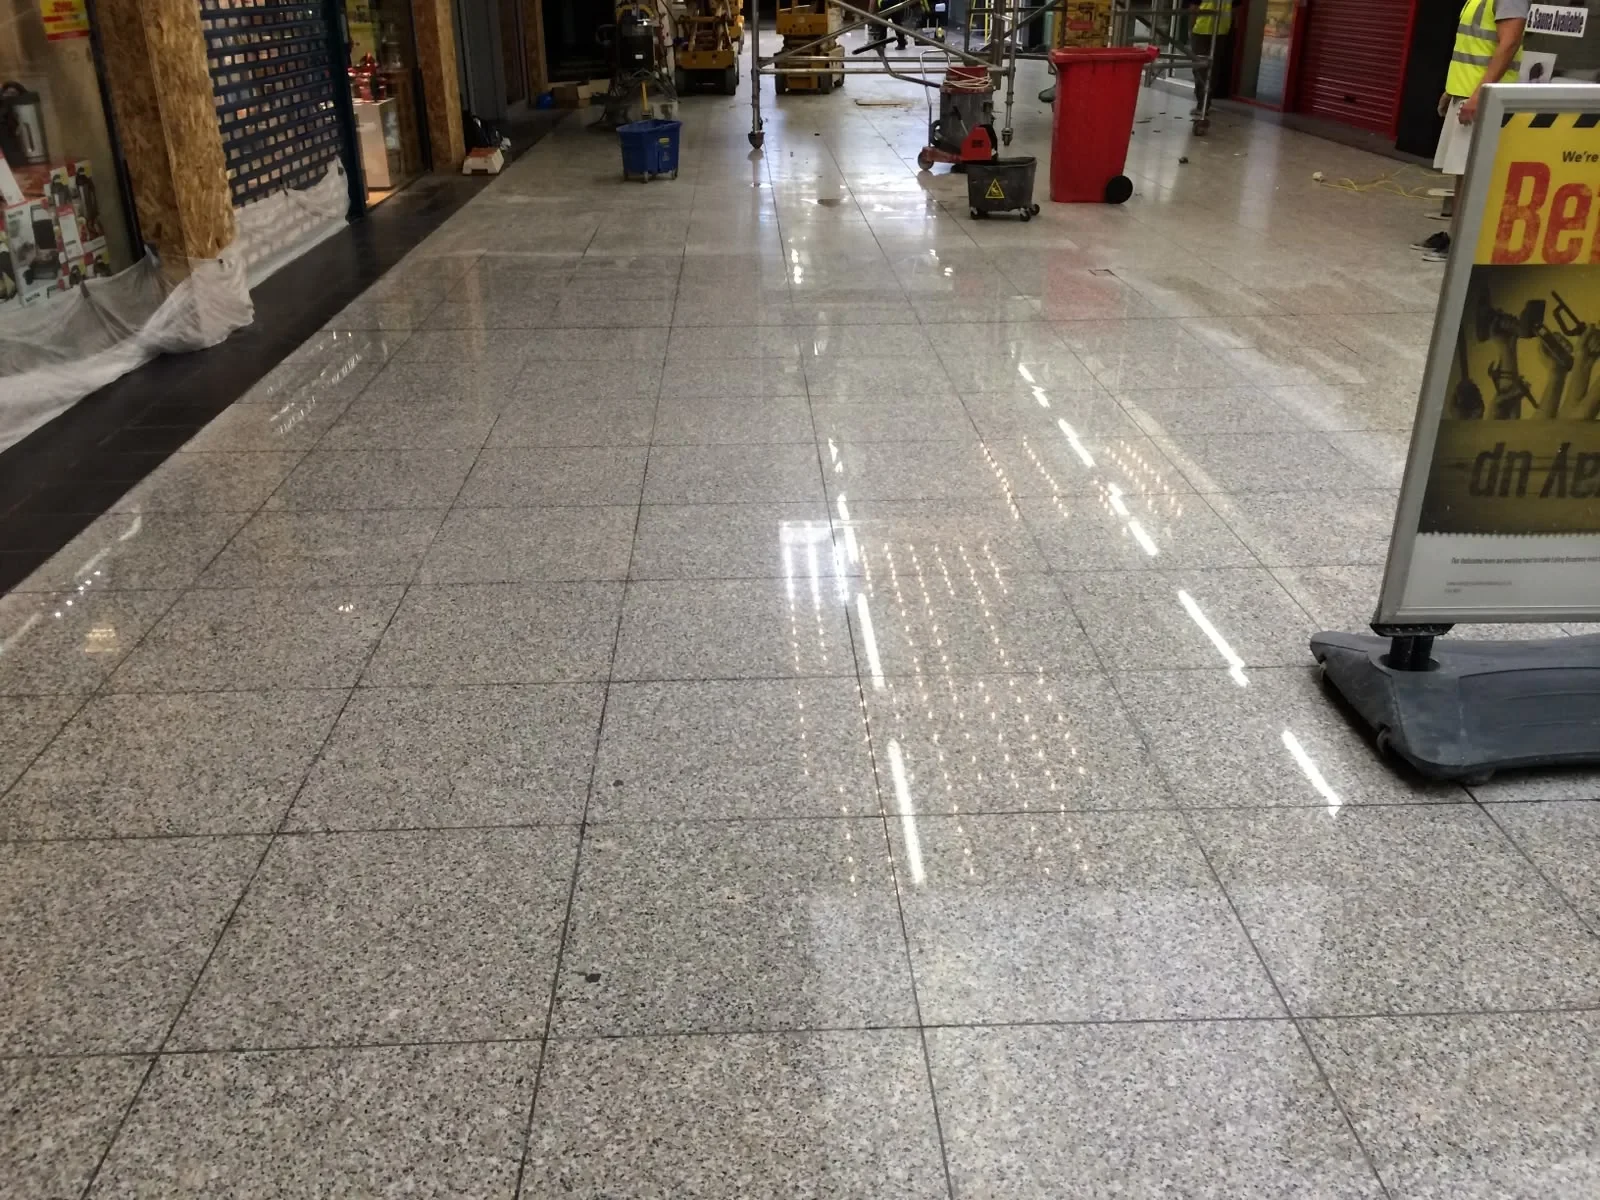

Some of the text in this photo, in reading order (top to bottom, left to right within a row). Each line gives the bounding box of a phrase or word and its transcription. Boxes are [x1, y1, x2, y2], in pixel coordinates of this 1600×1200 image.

[1532, 8, 1554, 31] Sauna
[1552, 10, 1584, 34] Available
[1562, 151, 1599, 163] We're
[1490, 161, 1600, 264] Be
[1539, 442, 1600, 499] ay
